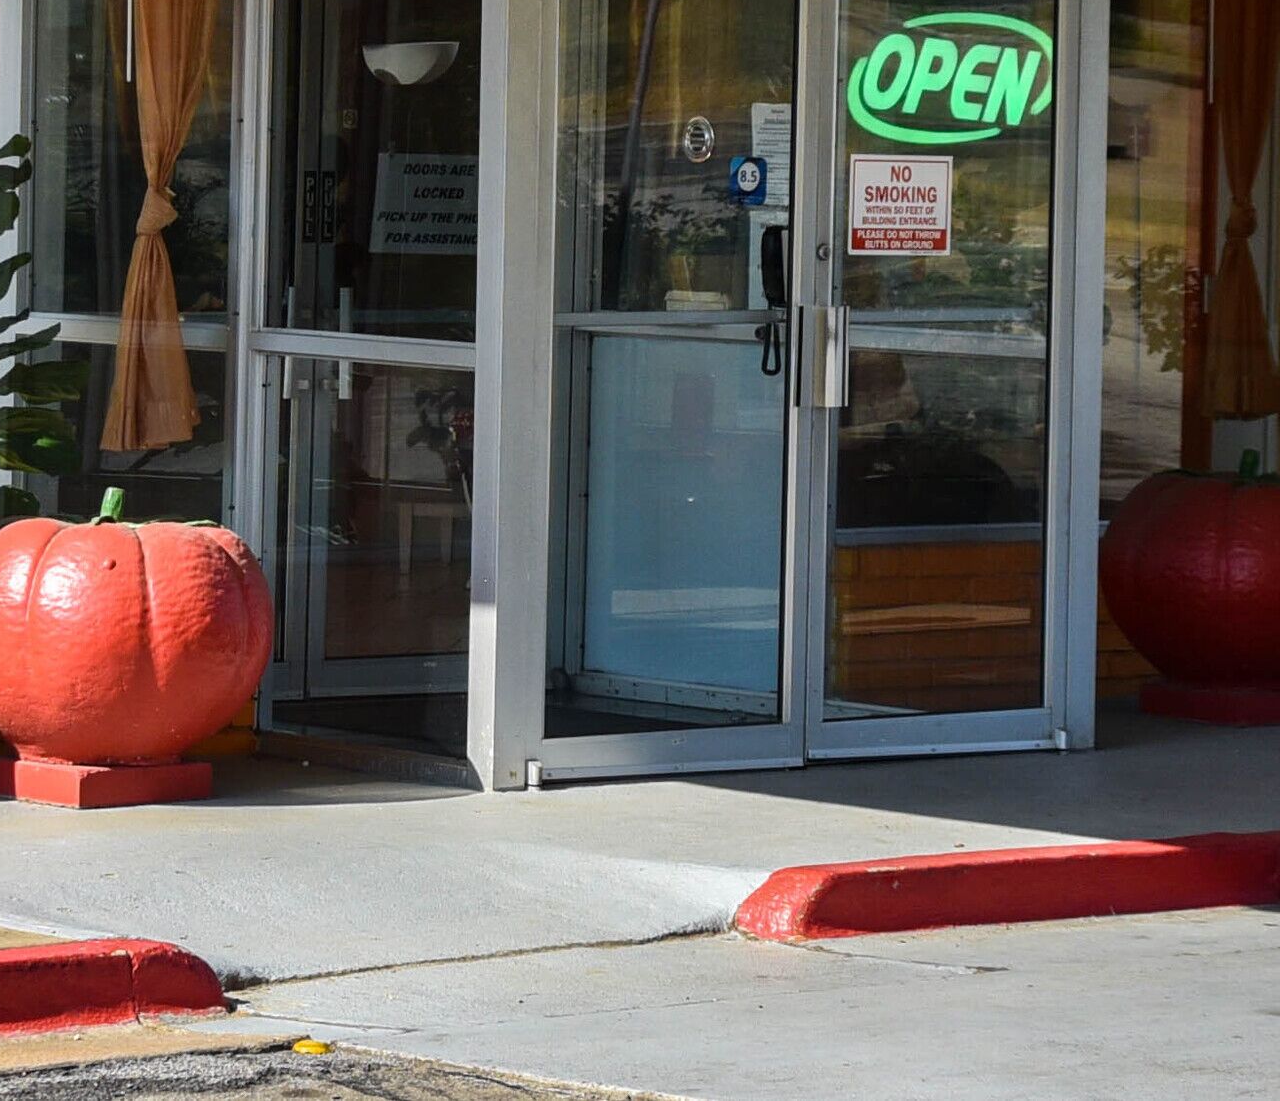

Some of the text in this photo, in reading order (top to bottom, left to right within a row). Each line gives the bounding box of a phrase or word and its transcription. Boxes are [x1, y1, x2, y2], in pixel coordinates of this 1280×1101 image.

[862, 33, 1042, 126] OPEN
[404, 163, 475, 176] DOORS ARE
[890, 165, 912, 183] NO
[740, 170, 757, 183] 8.5
[414, 187, 464, 199] LOCKED
[864, 185, 937, 203] SMOKING
[866, 205, 892, 215] WITHIN
[905, 206, 923, 215] FEET
[925, 206, 935, 215] OF
[377, 211, 407, 222] PICK
[410, 212, 428, 223] UP
[431, 212, 454, 223] THE
[862, 216, 937, 226] BUILDING ENTRANCE
[384, 233, 410, 244] FOR
[857, 229, 941, 240] PLEASE DO NOT THROW
[864, 240, 934, 249] BUTTS ON GROUND
